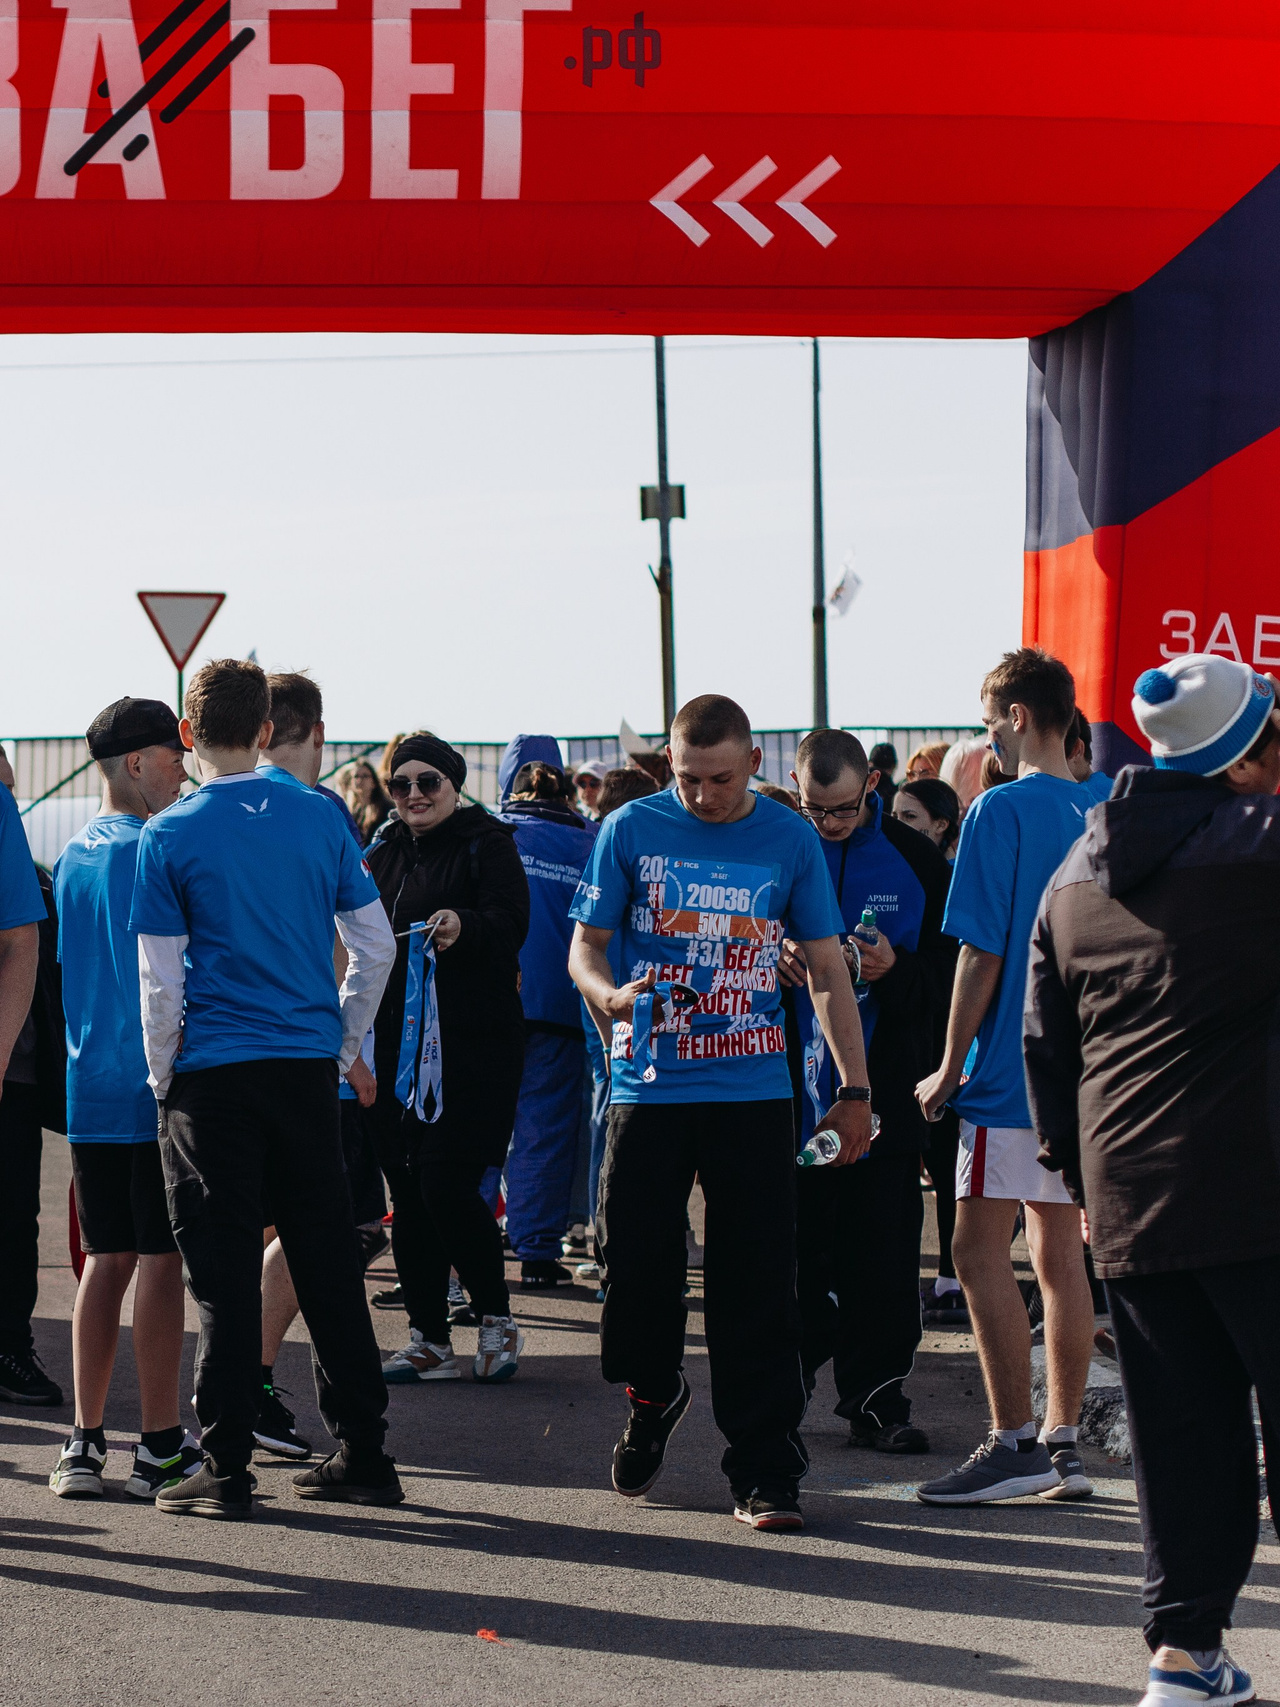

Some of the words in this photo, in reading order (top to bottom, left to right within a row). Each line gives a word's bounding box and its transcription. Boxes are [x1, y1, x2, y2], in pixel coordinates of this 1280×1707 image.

[639, 855, 669, 883] 20
[576, 880, 602, 900] ПСБ
[685, 883, 750, 913] 20036
[865, 903, 899, 912] РОССИИ
[677, 1024, 786, 1061] #ЕДИНСТВО
